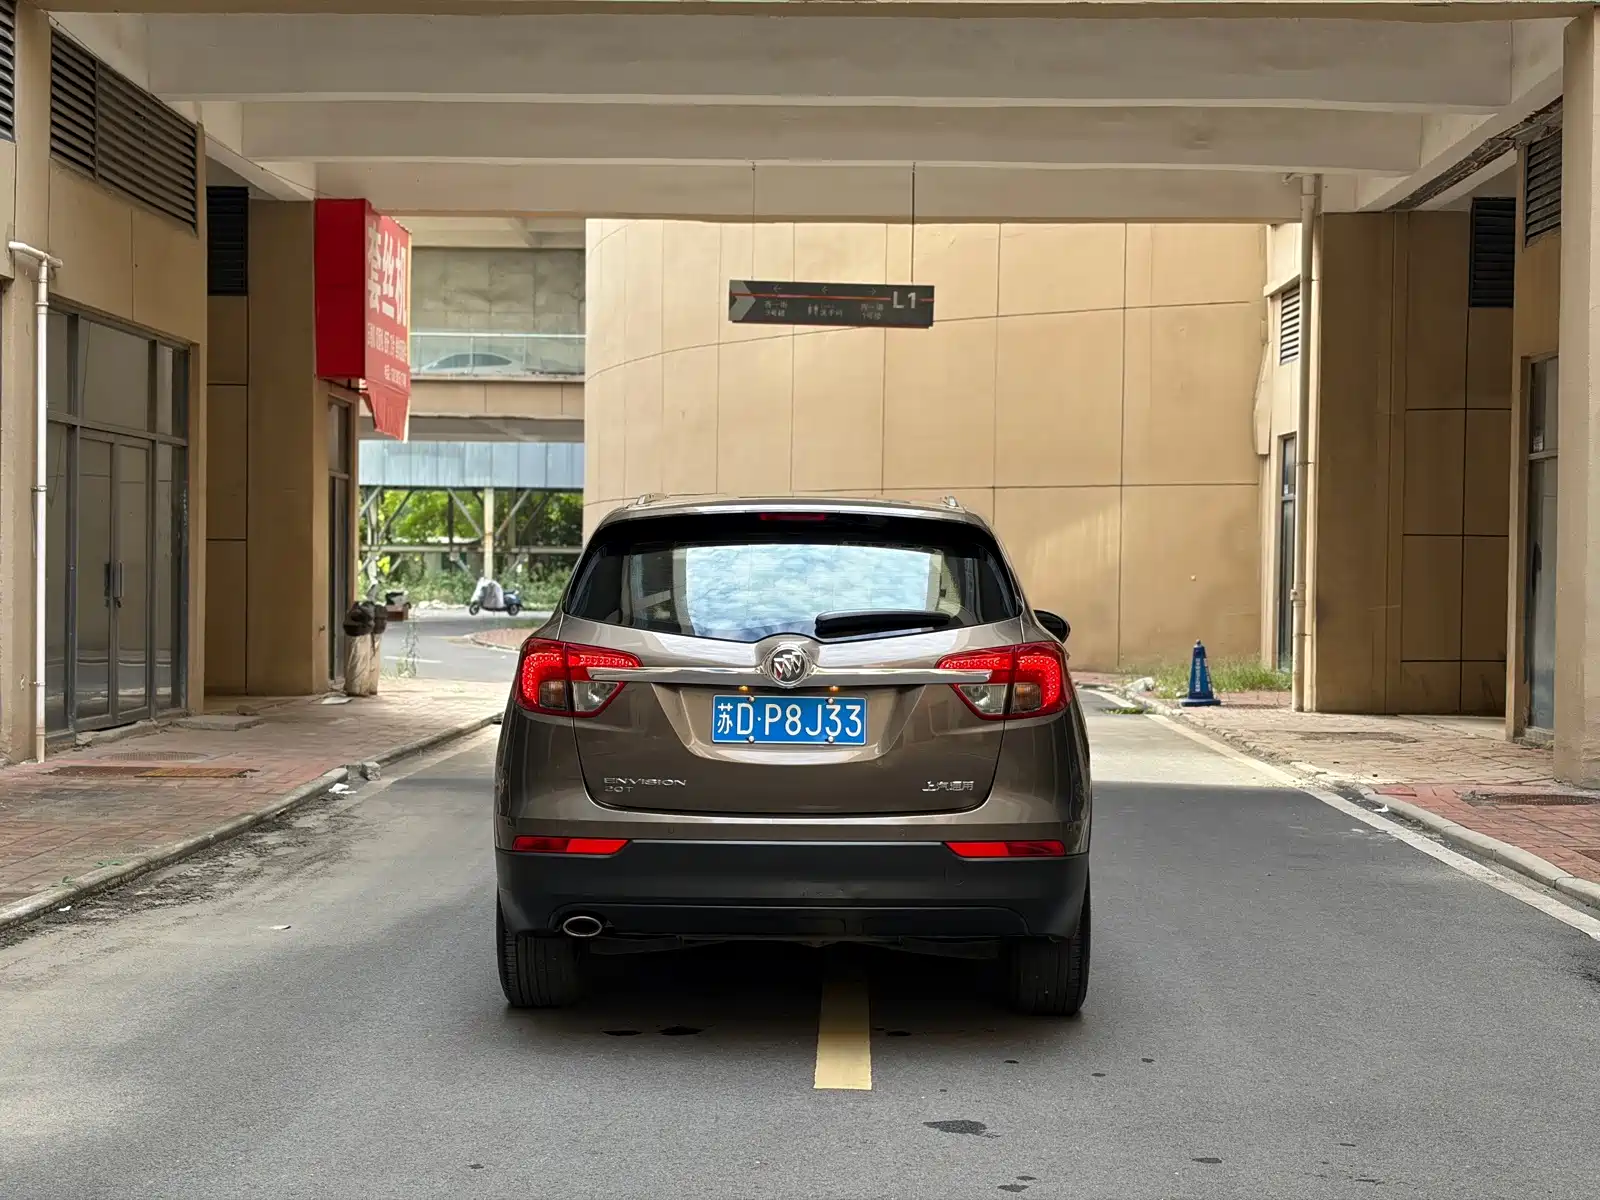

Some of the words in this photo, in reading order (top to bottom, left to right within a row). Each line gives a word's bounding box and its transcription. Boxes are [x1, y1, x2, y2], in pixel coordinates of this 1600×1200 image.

[367, 219, 407, 327] 套丝机
[893, 291, 916, 309] L1
[717, 703, 862, 737] 苏D·P8J33
[603, 777, 687, 786] ENVISION
[922, 781, 974, 791] 上汽通用
